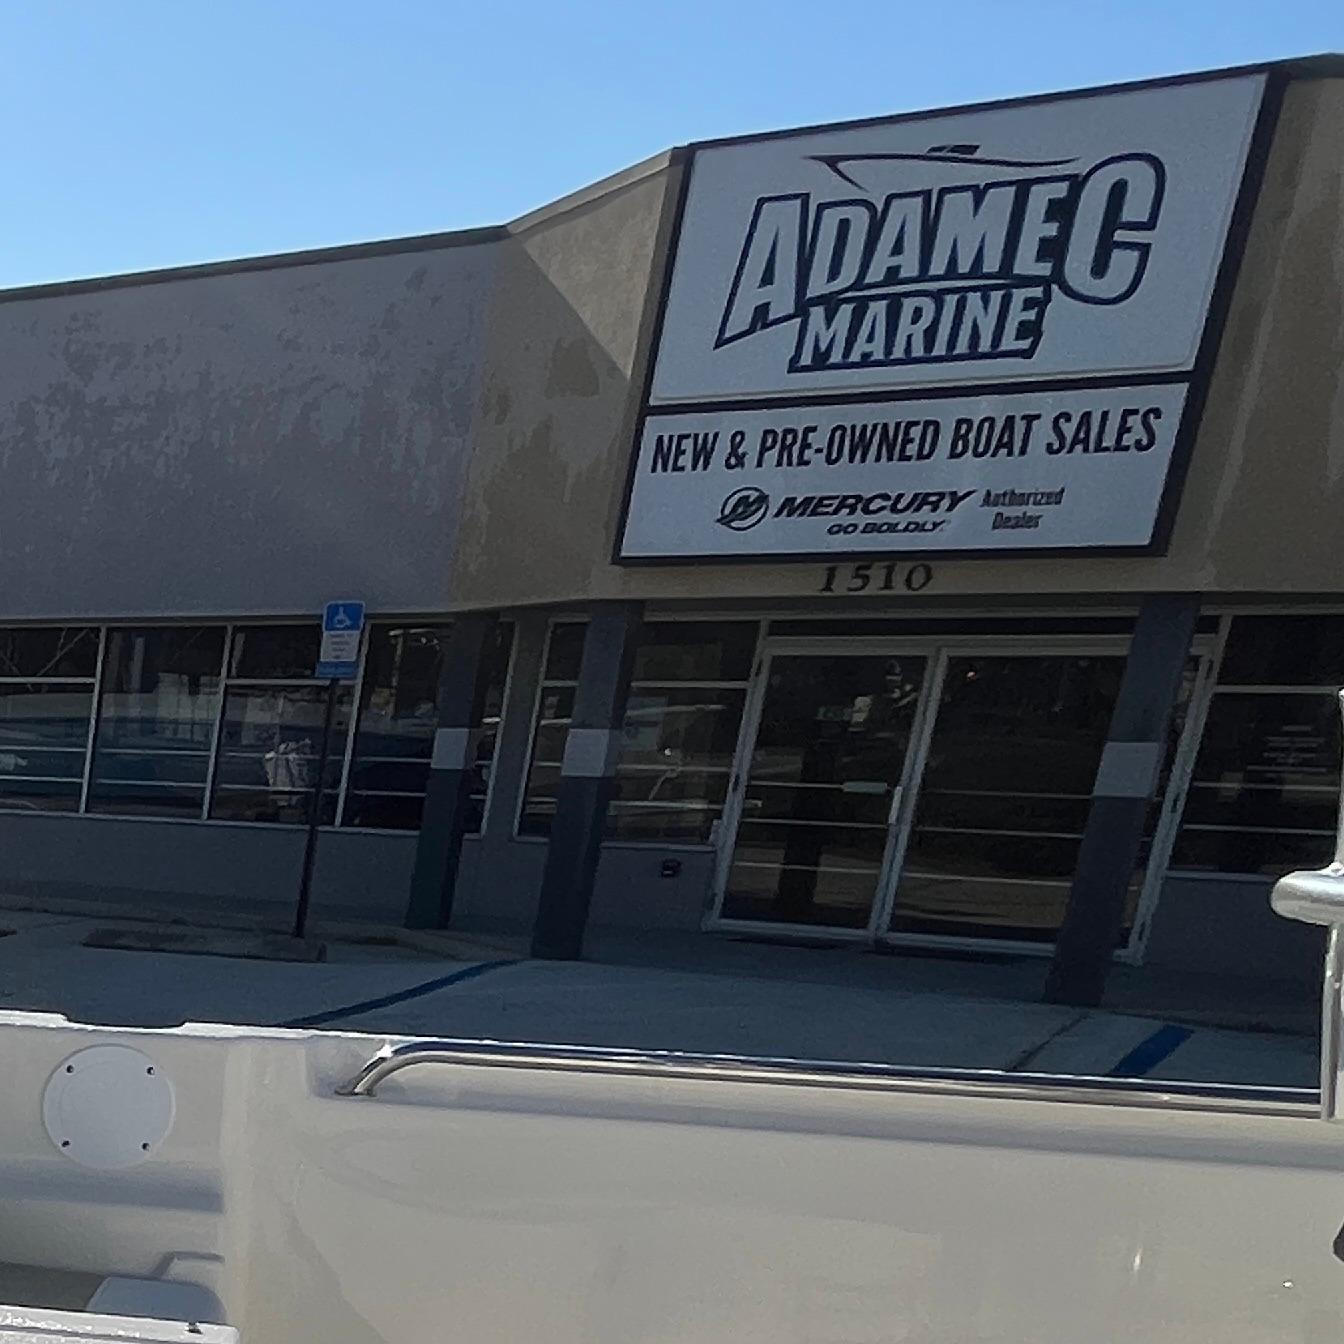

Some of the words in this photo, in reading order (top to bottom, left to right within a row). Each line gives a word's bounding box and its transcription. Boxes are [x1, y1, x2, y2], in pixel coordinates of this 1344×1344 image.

[714, 153, 1166, 349] ADAMEC
[788, 283, 1051, 373] MARINE
[650, 431, 719, 473] NEW
[724, 429, 750, 470] &
[755, 418, 941, 469] PRE-OWNED
[946, 413, 1041, 460] BOAT
[1045, 406, 1162, 457] SALES
[772, 489, 978, 519] MERCURY
[826, 522, 859, 536] GO
[861, 519, 947, 535] BOLDLY
[817, 562, 935, 595] 1510
